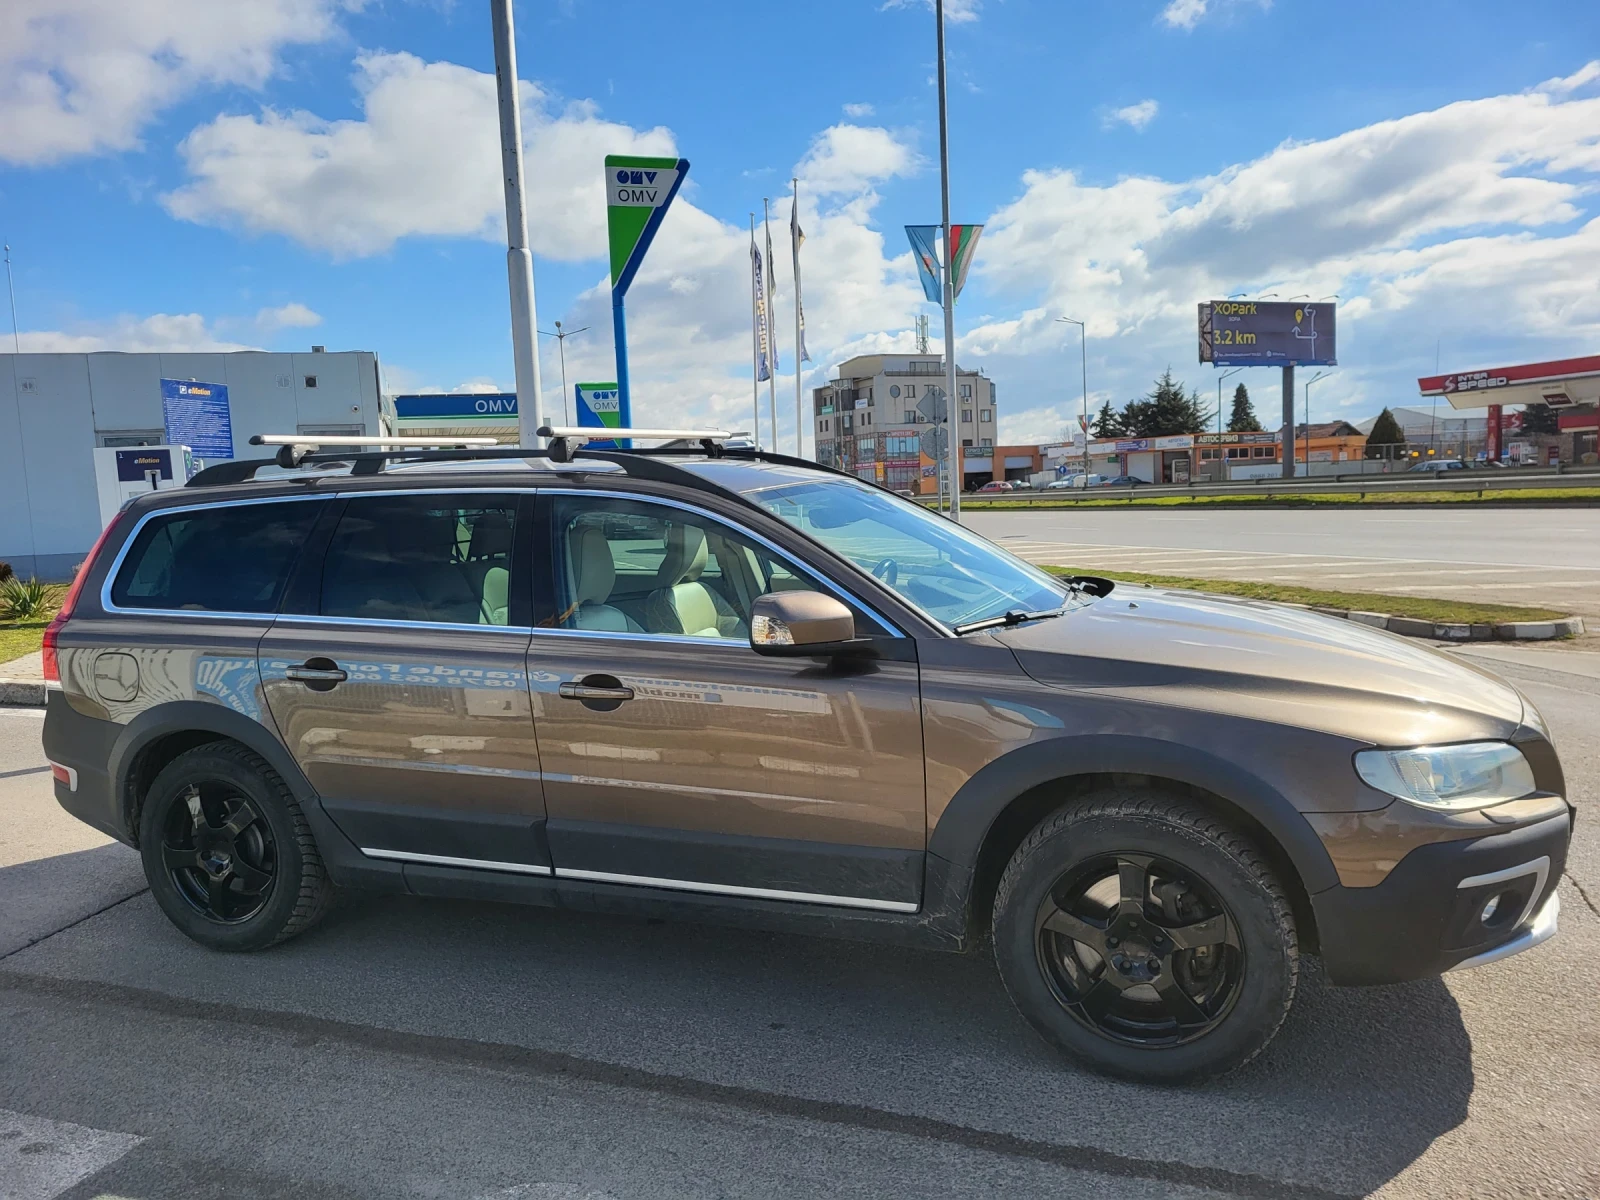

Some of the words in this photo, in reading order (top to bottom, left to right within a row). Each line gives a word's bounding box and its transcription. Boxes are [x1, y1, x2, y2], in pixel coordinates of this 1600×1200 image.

[616, 169, 658, 185] OMV
[618, 189, 658, 203] OMV
[1213, 303, 1257, 315] XOPark
[1213, 329, 1233, 345] 3.2
[1235, 329, 1256, 345] km
[1457, 372, 1488, 381] INTER
[1457, 377, 1507, 391] SPEED
[188, 387, 211, 396] eMotion
[475, 399, 516, 413] OMV
[593, 402, 618, 410] OMV
[134, 457, 160, 465] eMotion
